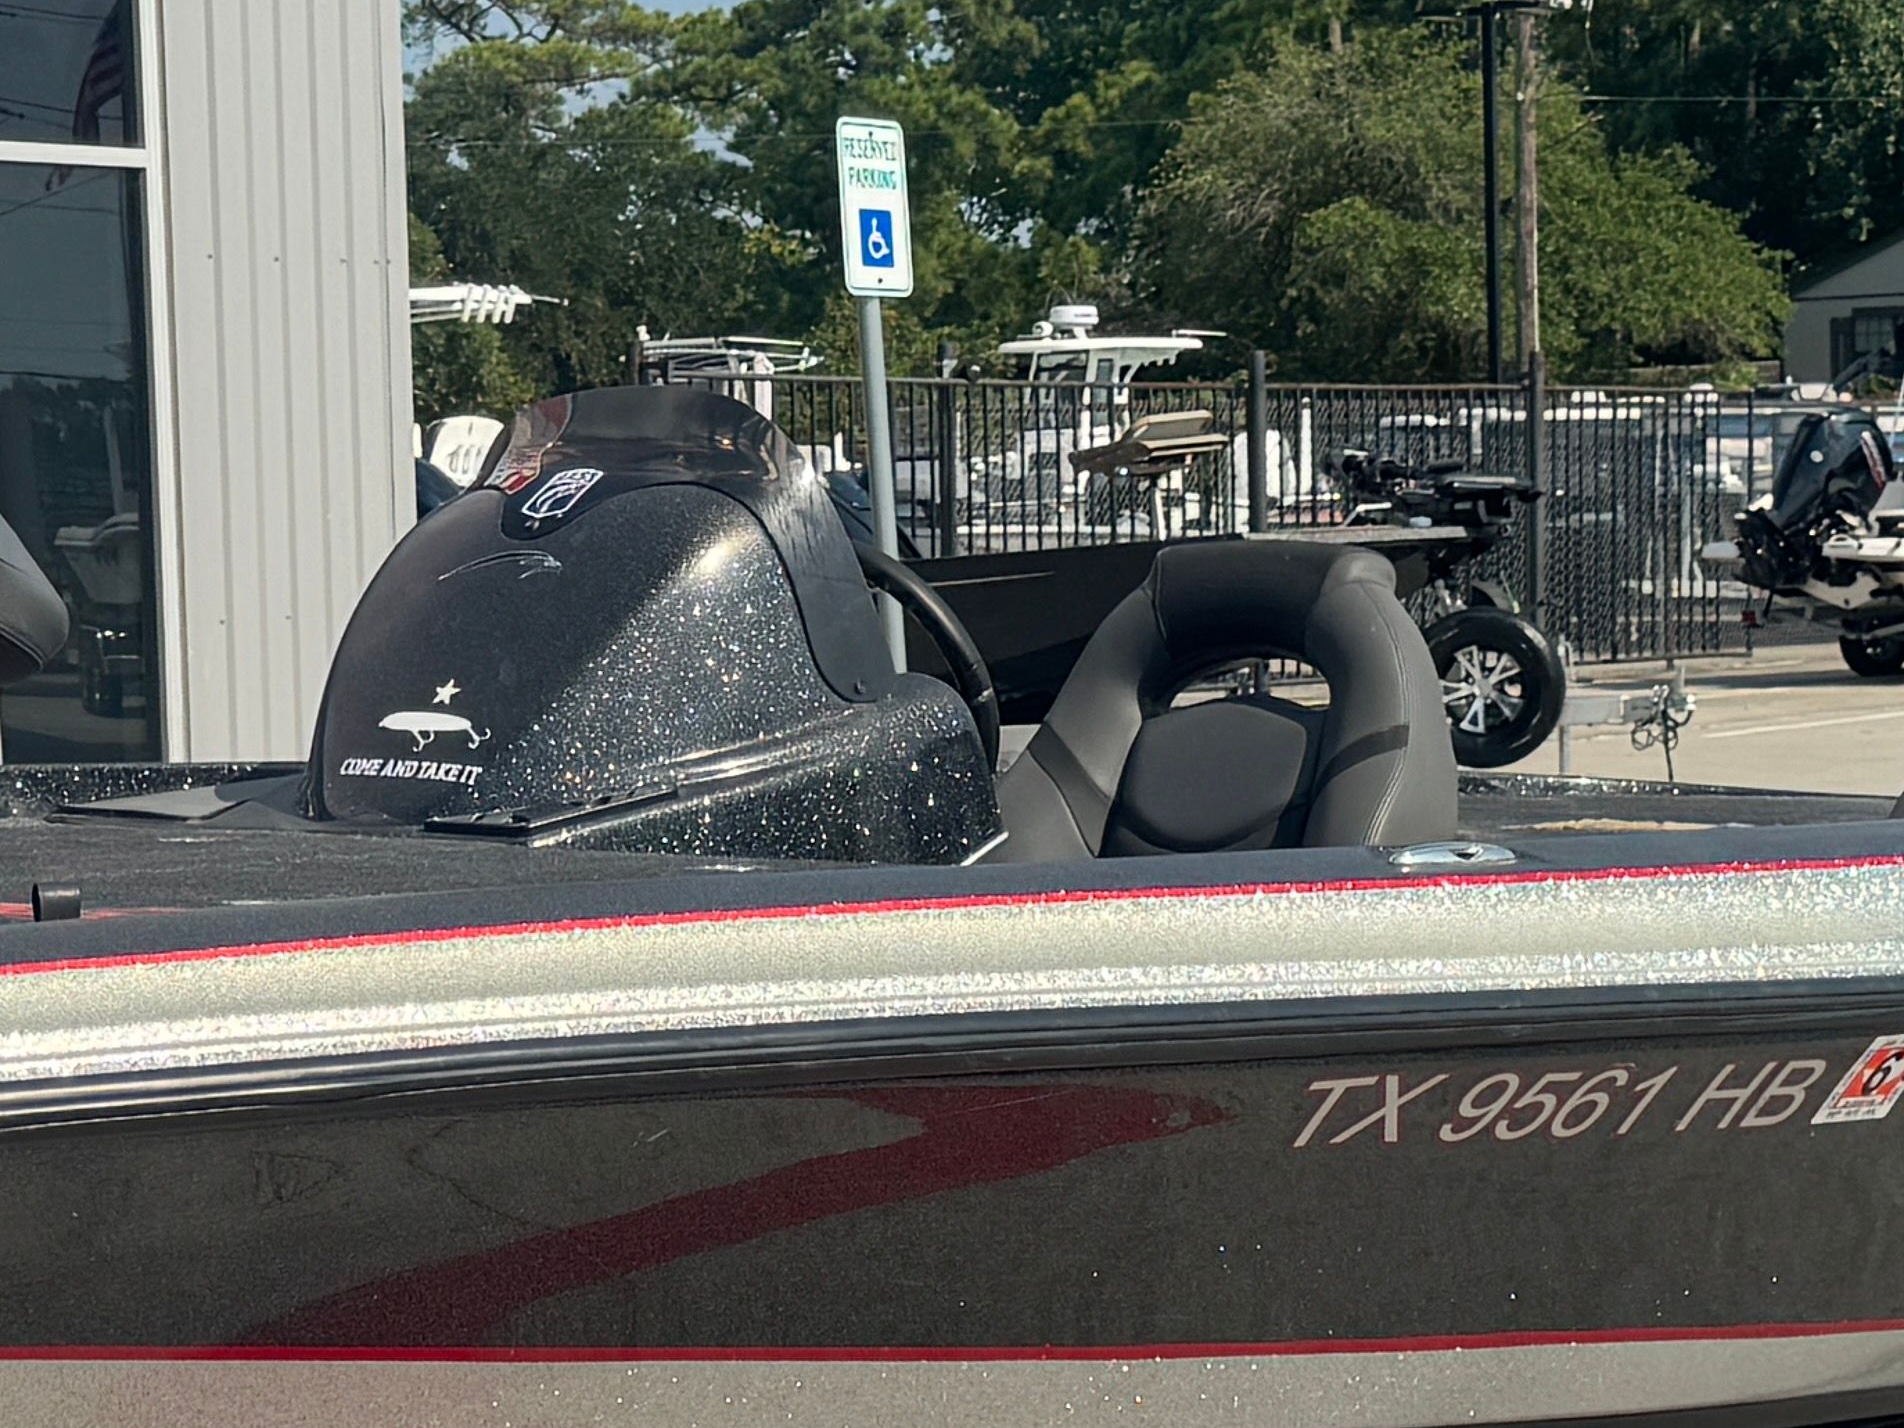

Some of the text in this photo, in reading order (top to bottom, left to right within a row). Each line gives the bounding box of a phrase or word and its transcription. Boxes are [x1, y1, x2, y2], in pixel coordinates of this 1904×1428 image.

[340, 757, 484, 786] COME AND TAKE IT
[1293, 1059, 1827, 1148] TX 9561 HB
